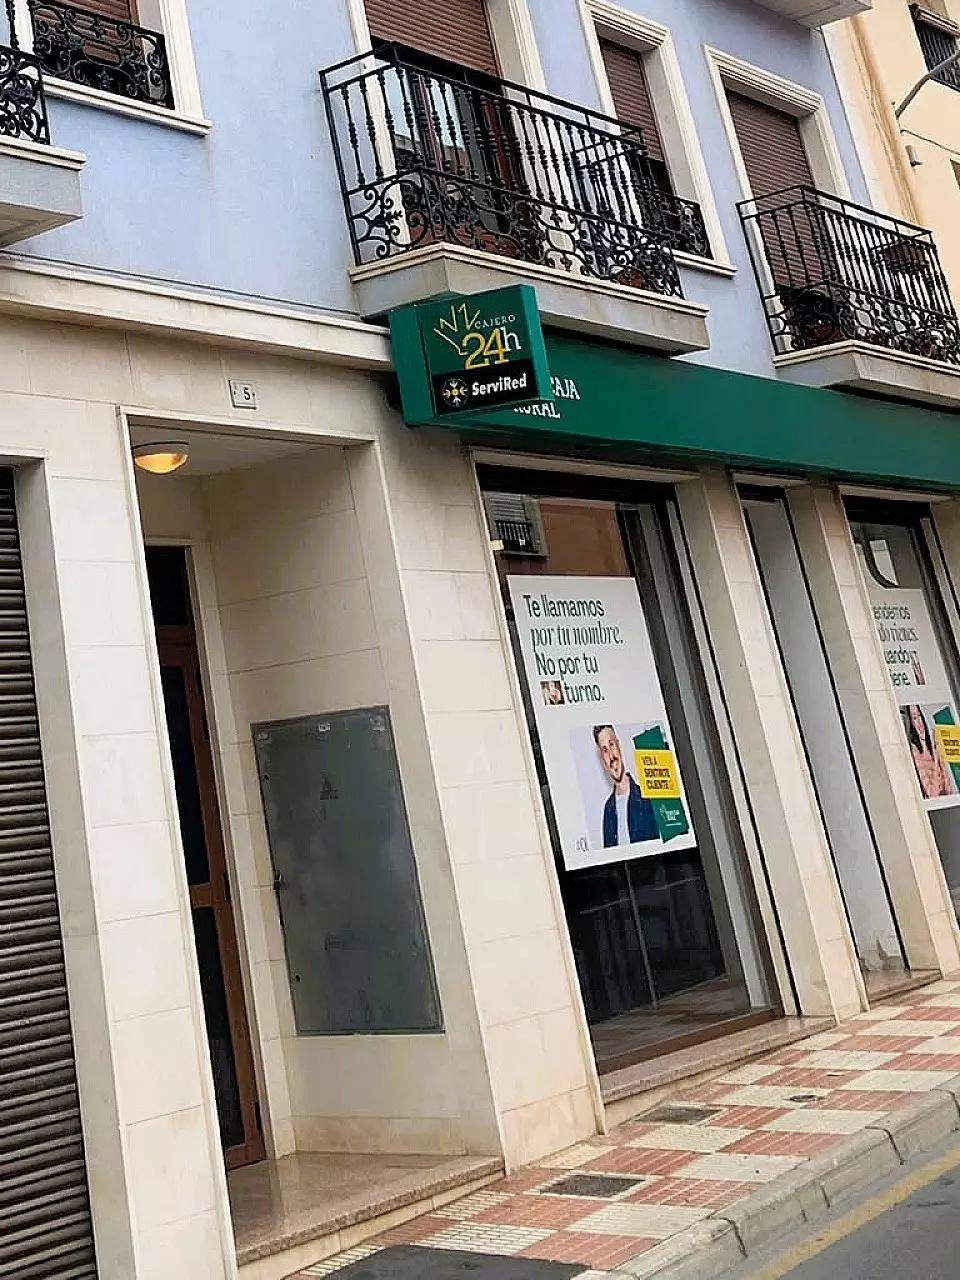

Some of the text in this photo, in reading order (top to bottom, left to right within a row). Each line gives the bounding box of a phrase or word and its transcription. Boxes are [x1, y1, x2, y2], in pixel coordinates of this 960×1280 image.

[474, 314, 516, 329] CAJERO
[461, 325, 522, 371] 24h
[243, 387, 251, 401] 5
[471, 371, 527, 396] ServiRed
[522, 593, 606, 617] Te llamamos
[530, 620, 624, 653] por tu nombre.
[534, 652, 600, 681] No por tu
[563, 682, 606, 704] turno.
